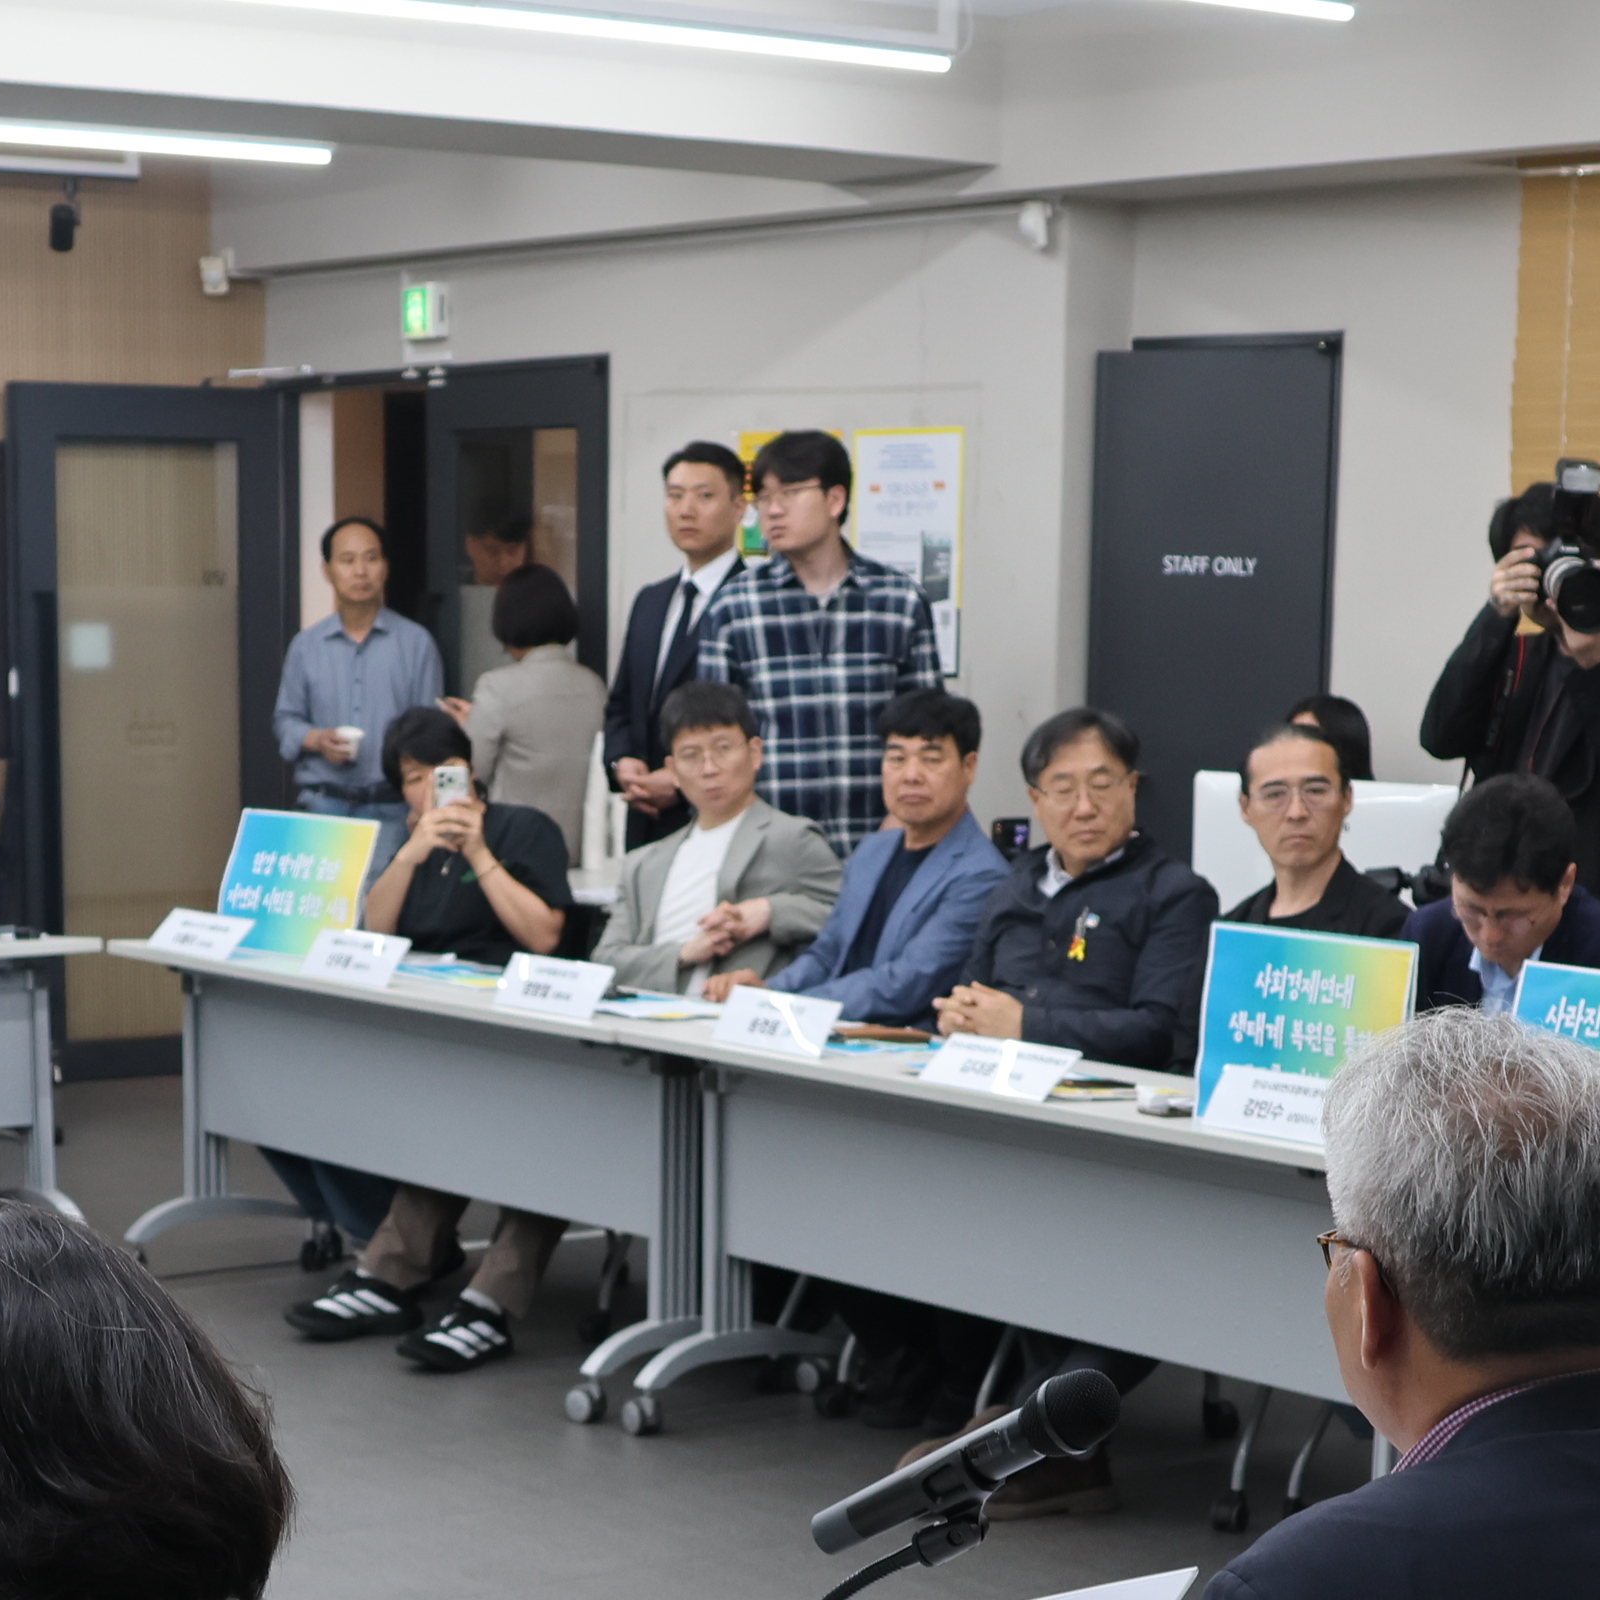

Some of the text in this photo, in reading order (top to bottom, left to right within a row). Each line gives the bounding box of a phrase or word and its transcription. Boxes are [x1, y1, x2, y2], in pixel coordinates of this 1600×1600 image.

[1162, 555, 1257, 577] STAFF ONLY
[1255, 962, 1356, 1009] 사회경제연대
[1229, 1010, 1285, 1049] 생태계
[1292, 1020, 1336, 1057] 복원을
